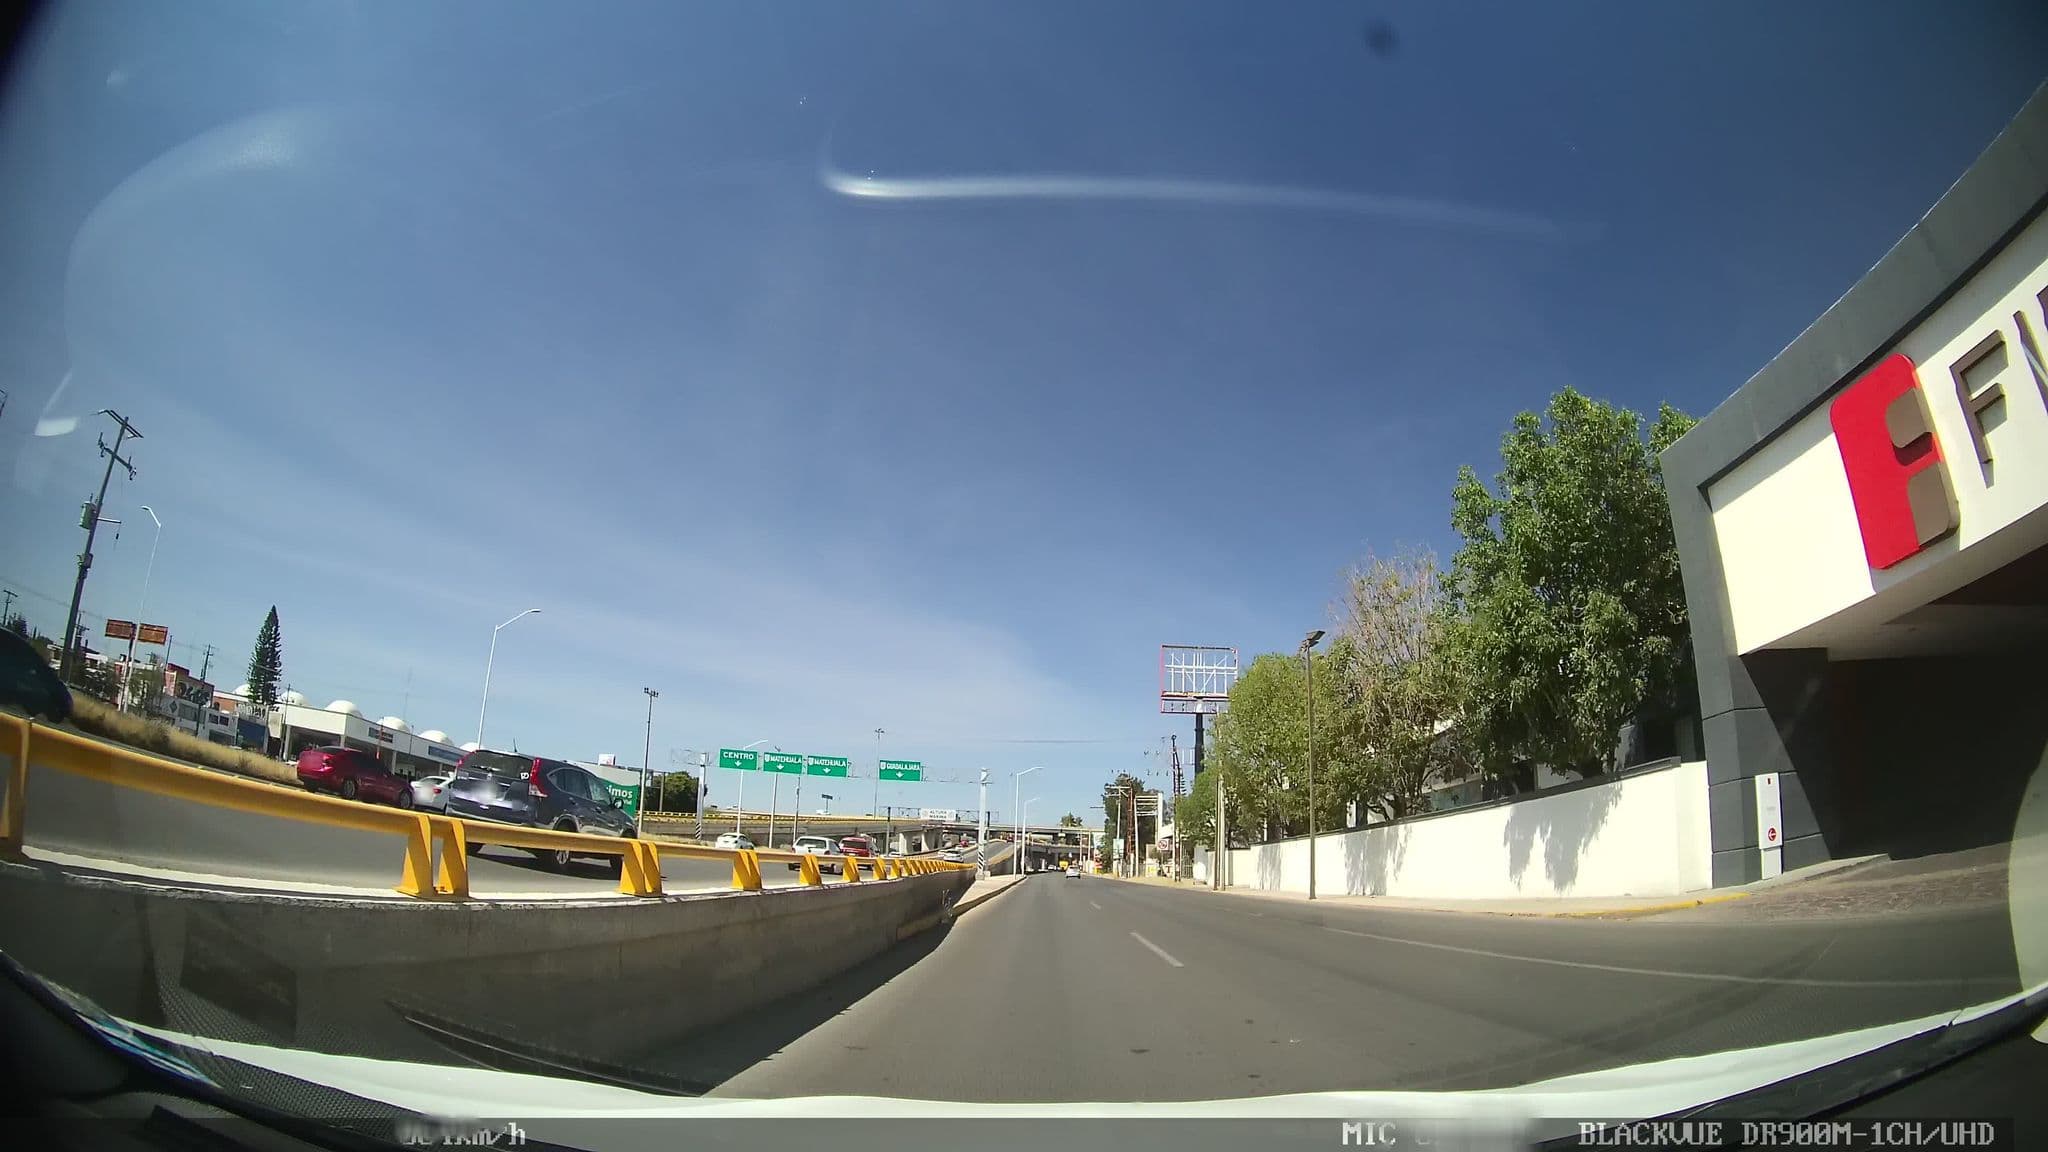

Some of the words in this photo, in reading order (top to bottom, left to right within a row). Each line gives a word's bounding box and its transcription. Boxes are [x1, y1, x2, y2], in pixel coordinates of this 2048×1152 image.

[723, 751, 754, 760] CENTRO
[770, 754, 802, 764] MATEHUALA
[814, 758, 846, 767] MATEHUALA
[606, 785, 633, 798] imos
